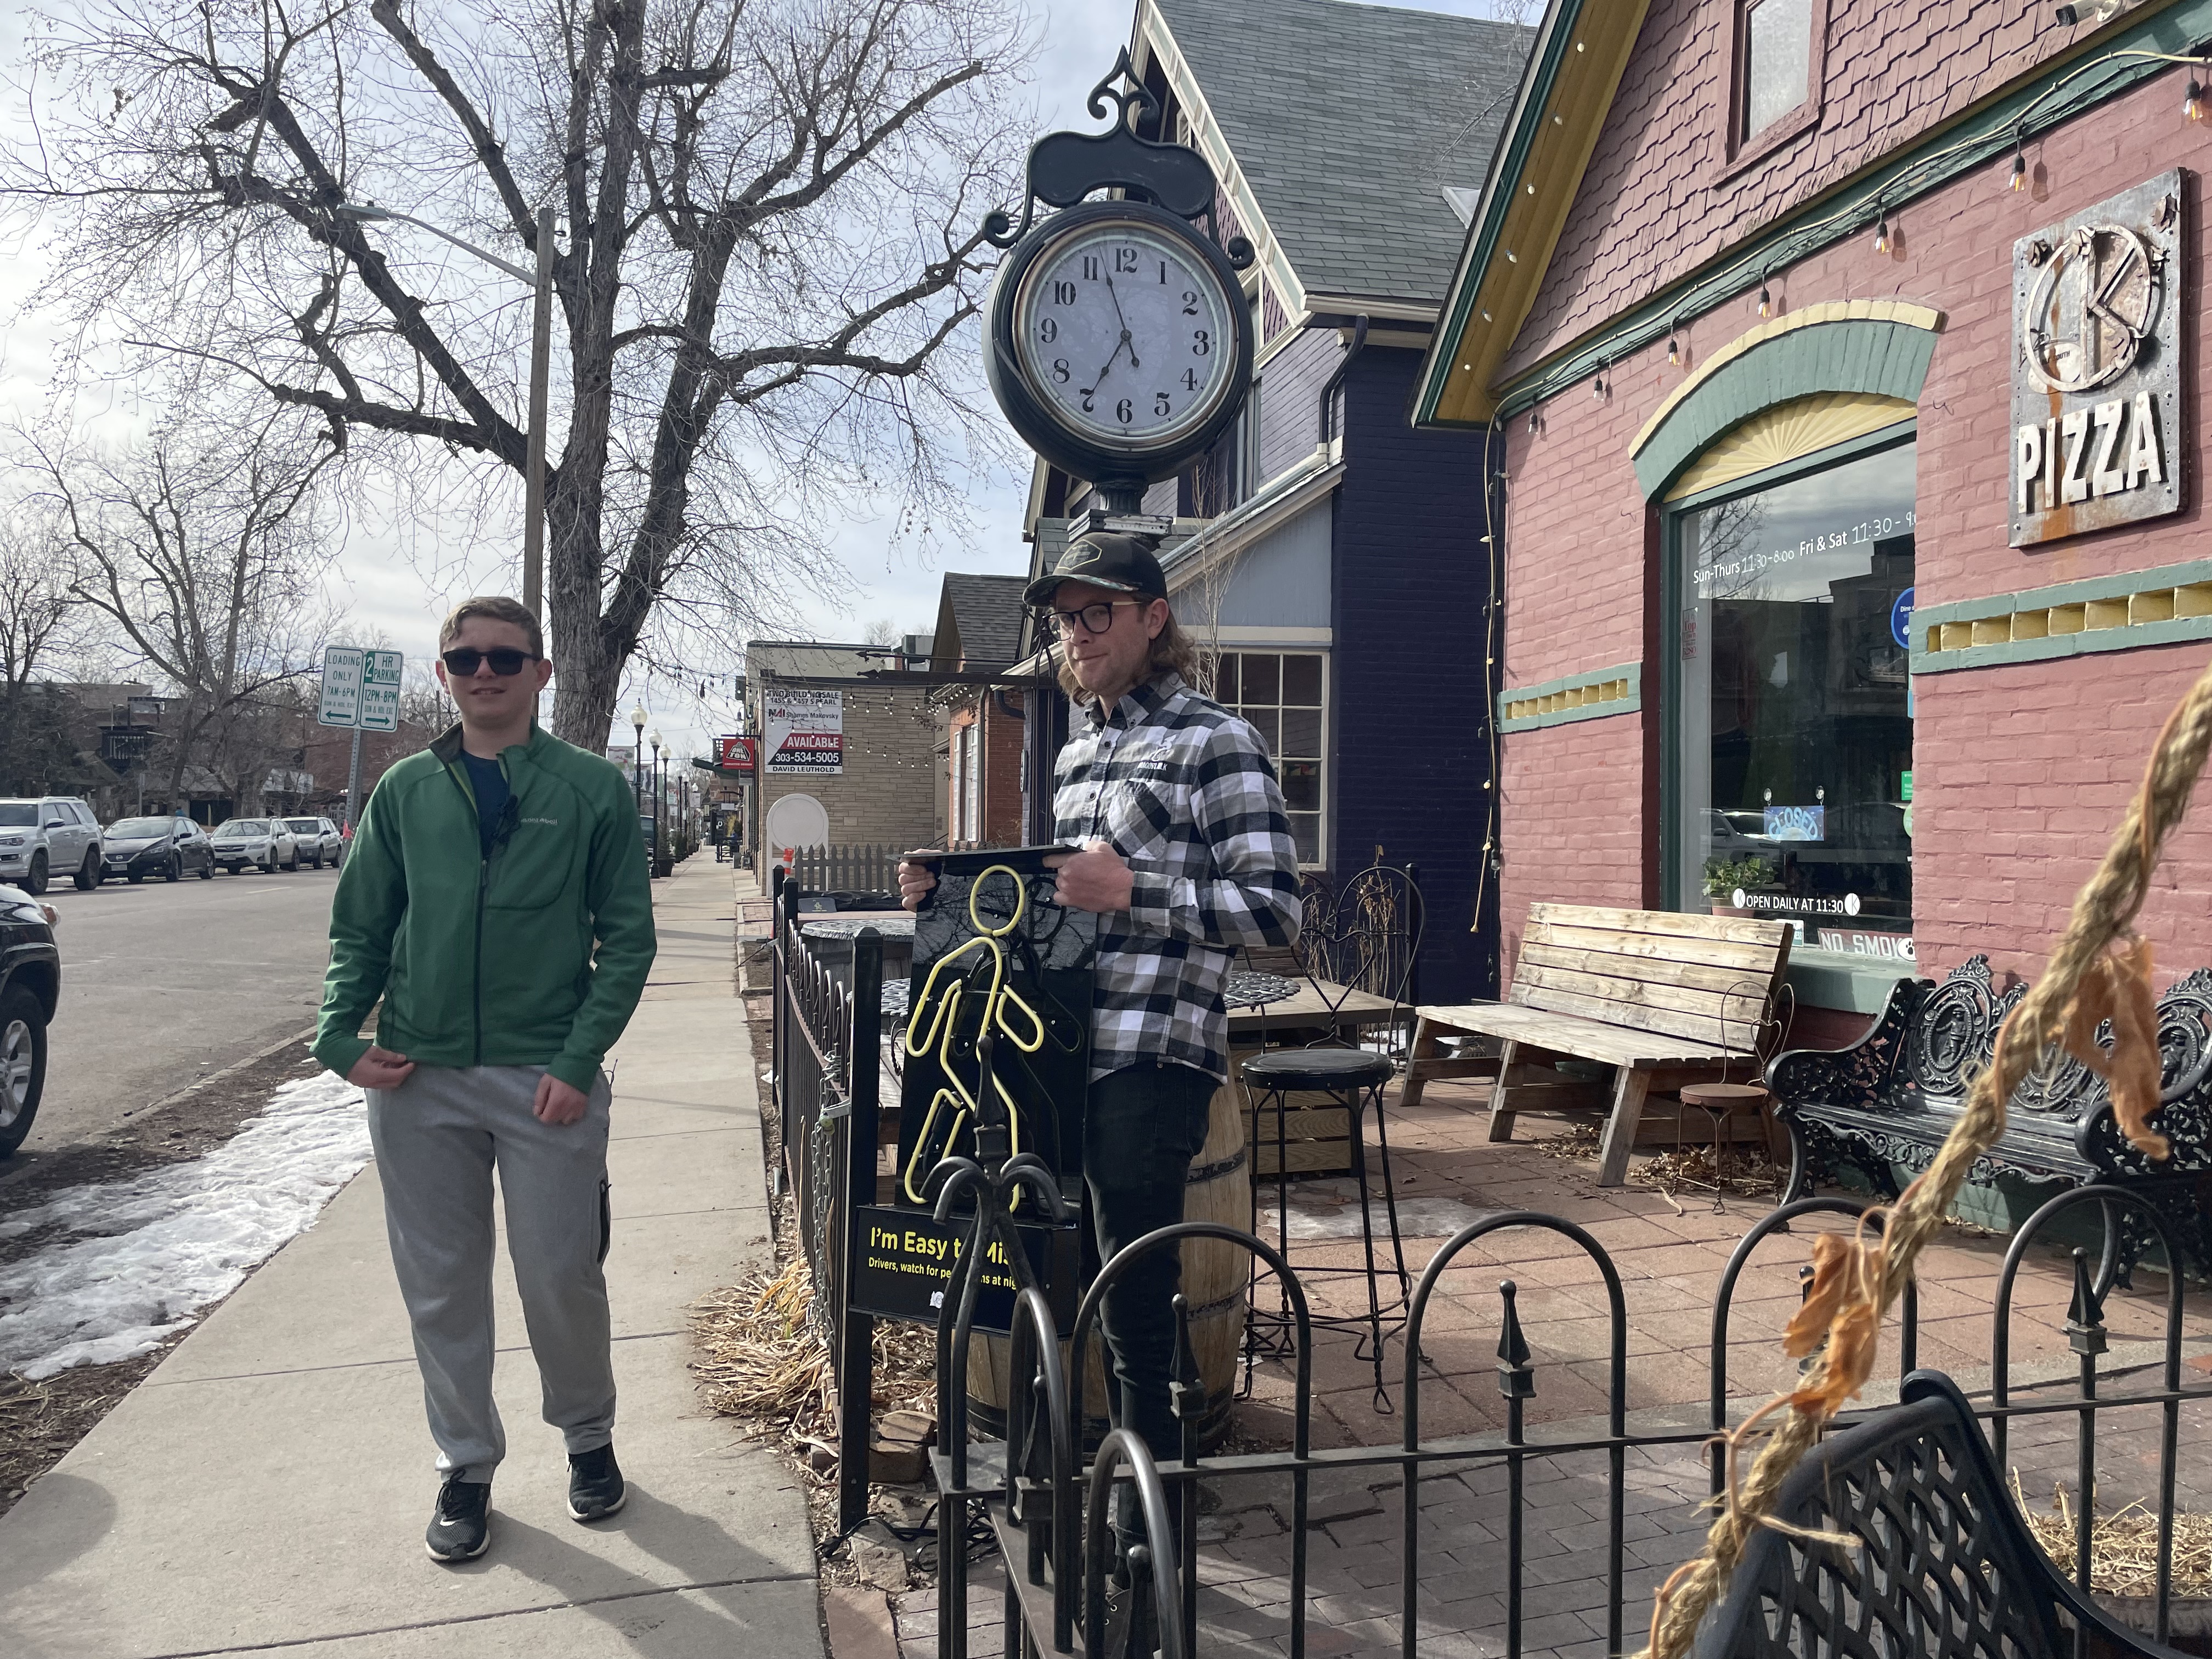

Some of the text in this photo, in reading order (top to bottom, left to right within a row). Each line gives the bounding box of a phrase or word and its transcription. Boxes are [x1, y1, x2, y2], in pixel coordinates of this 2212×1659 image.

[1082, 256, 1099, 281] 11
[1115, 248, 1138, 273] 12
[1160, 261, 1167, 284] 1
[1054, 280, 1076, 306] 10
[1182, 291, 1198, 315] 2
[1041, 318, 1058, 343] 9
[1192, 330, 1209, 356] 3
[1053, 358, 1070, 383] 8
[1180, 368, 1198, 391] 4
[1079, 388, 1094, 413] 7
[1116, 398, 1133, 424] 6
[1154, 392, 1170, 416] 5
[2018, 391, 2162, 514] PIZZA
[1693, 560, 1740, 584] Sun-Thurs
[1799, 539, 1814, 557] Fri
[1816, 536, 1826, 551] &
[1829, 531, 1848, 549] Sat
[1851, 517, 1892, 545] 11:30
[328, 654, 360, 666] LOADING
[365, 656, 393, 678] 2 HR
[333, 670, 352, 681] ONLY
[373, 669, 399, 682] PARKING
[769, 708, 785, 718] NAI
[787, 737, 839, 748] AVAILABLE
[775, 752, 839, 763] 303-534-5005
[1768, 807, 1818, 840] CLOSED
[1746, 895, 1844, 913] OPEN DAILY AT 11:30
[1852, 934, 1903, 957] SMOK
[904, 1231, 947, 1261] Easy
[953, 1238, 962, 1259] t
[868, 1257, 898, 1273] Drivers,
[900, 1262, 924, 1276] watch
[926, 1265, 939, 1277] for
[992, 1276, 1001, 1286] at
[1003, 1276, 1017, 1290] nig
